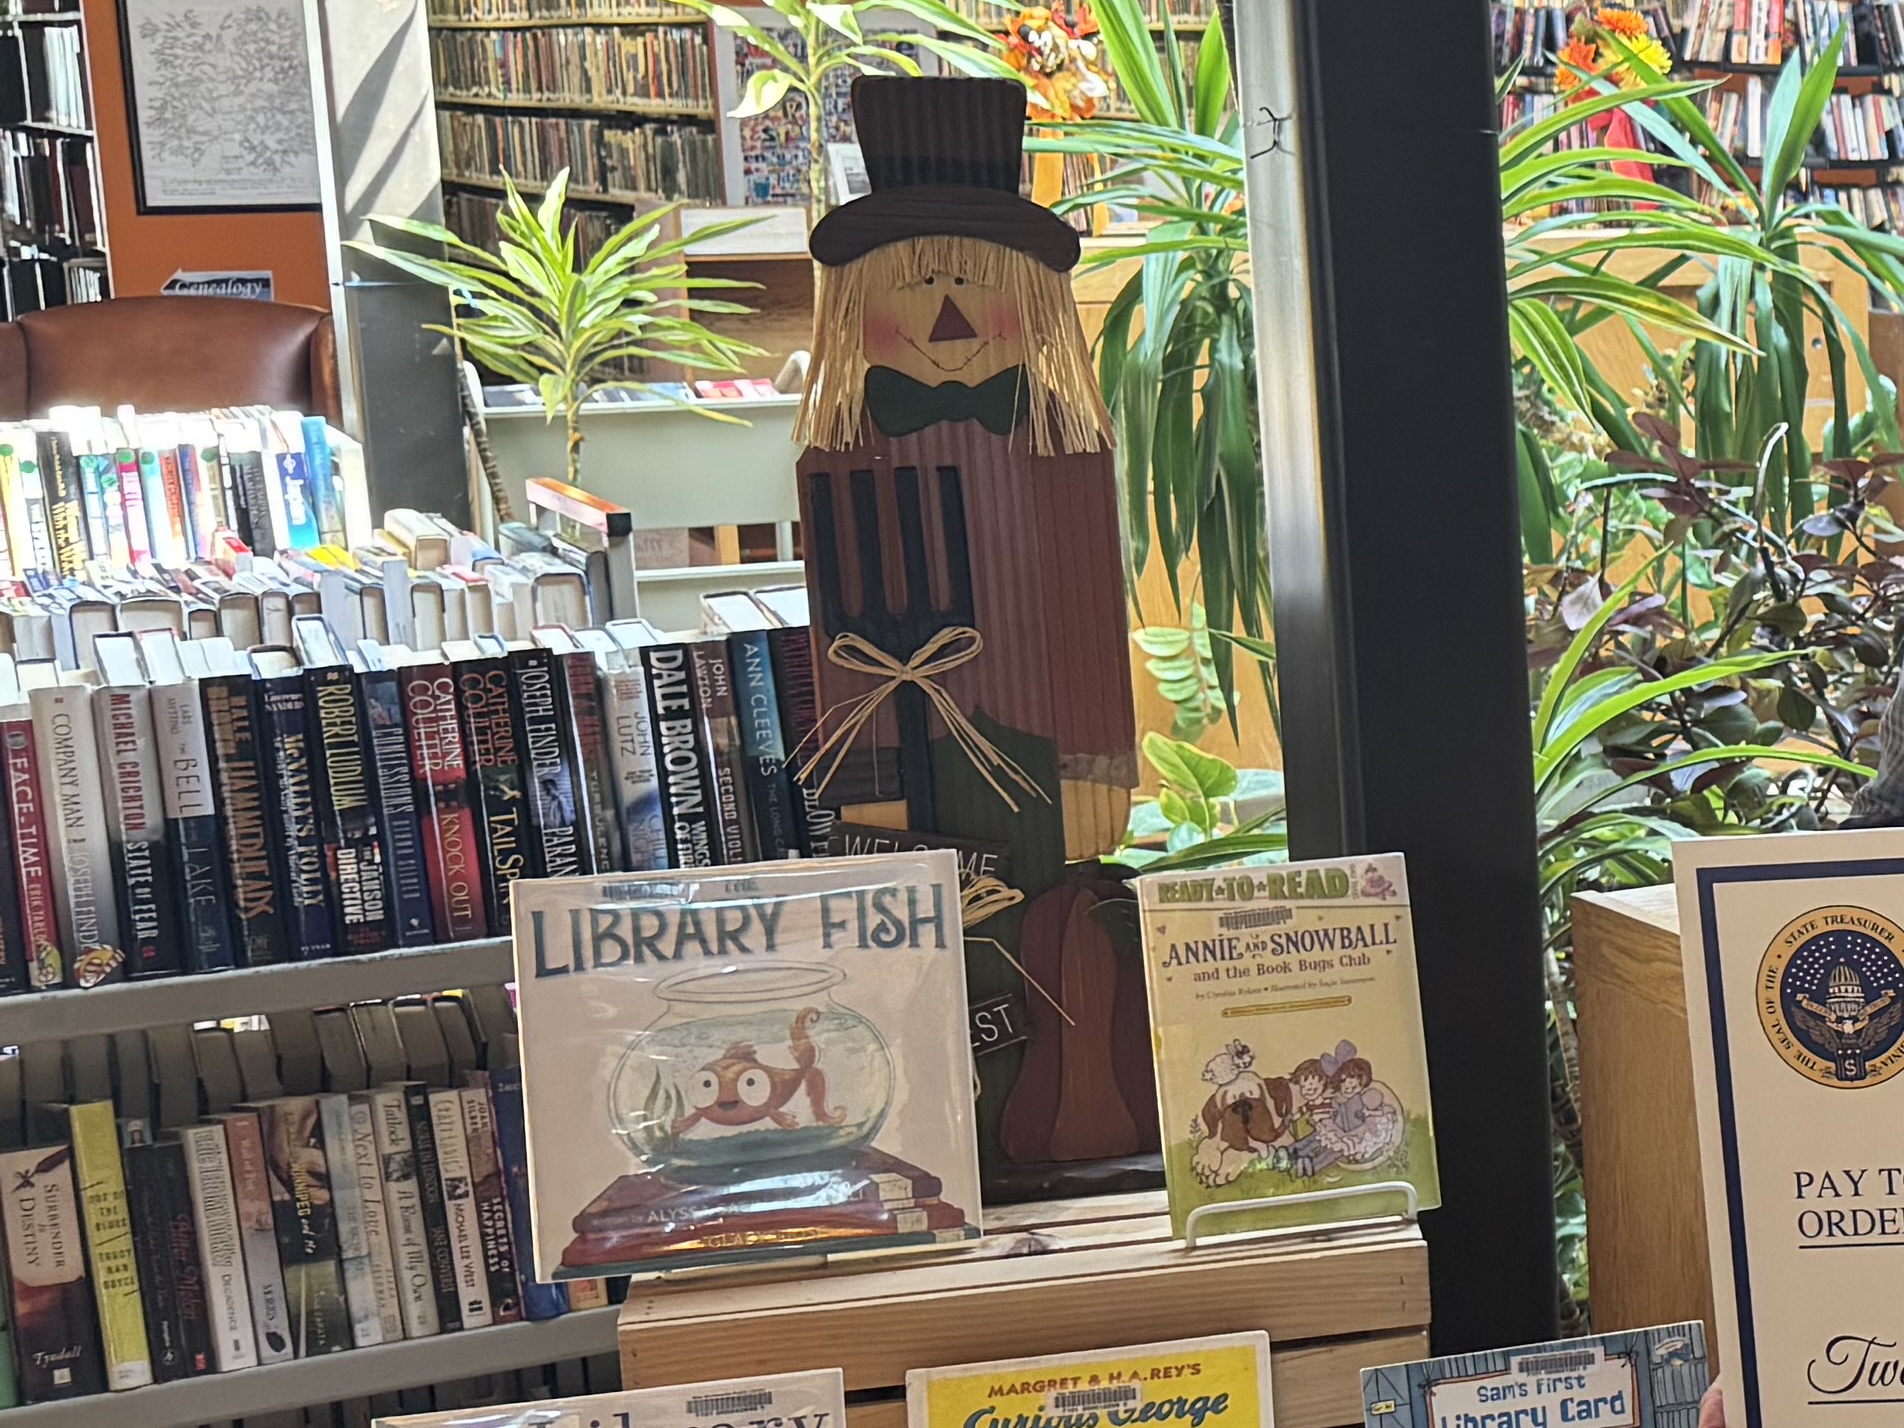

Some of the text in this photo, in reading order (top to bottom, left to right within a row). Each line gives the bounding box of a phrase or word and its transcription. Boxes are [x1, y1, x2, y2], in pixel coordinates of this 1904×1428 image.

[175, 278, 262, 299] Genealogy
[515, 665, 555, 720] JOSEPH
[709, 657, 728, 697] JOHN
[407, 679, 443, 774] COULTER
[432, 677, 464, 772] CATHERINE
[460, 673, 497, 771] COULTER
[484, 670, 518, 766] CATHERINE
[616, 715, 637, 759] LUTZ
[634, 711, 653, 758] JOHN
[650, 649, 705, 816] DALE BROWN
[744, 643, 778, 778] ANN CLEEVES
[51, 712, 85, 828] COMPANY MAN
[109, 693, 148, 832] MICHAEL CRICHTON
[316, 684, 369, 811] ROBERT LUDLUM
[173, 757, 204, 815] BELL
[717, 766, 740, 820] SECOND
[9, 757, 42, 878] FACE-TIME
[126, 840, 160, 942] STATE FEAR
[337, 847, 365, 925] DIRECTIVE
[359, 860, 385, 922] JANSON
[439, 813, 472, 921] KNOCK OUT
[1266, 867, 1350, 901] READ
[530, 882, 948, 980] LIBRARY FISH
[1162, 922, 1398, 968] ANNIE AND SNOWBALL
[1783, 919, 1819, 948] STATE
[1822, 913, 1896, 945] TREASURER
[1193, 952, 1371, 983] and the Book Bugs Club
[1765, 965, 1779, 991] THE
[1765, 997, 1777, 1015] OF
[1770, 1017, 1794, 1051] SEAL
[354, 1129, 381, 1237] Next Love
[1793, 1168, 1871, 1202] PAY
[19, 1197, 41, 1267] DESTINY
[44, 1183, 65, 1269] SURRENDER
[99, 1206, 118, 1218] THE
[479, 1201, 498, 1273] HAPPINESS
[492, 1196, 512, 1253] SECRETS
[102, 1276, 136, 1291] BOYCE
[410, 1274, 428, 1304] Own
[459, 1244, 475, 1289] LEE WEST
[987, 1362, 1203, 1399] MARGRET & H.A.REY'S
[1476, 1375, 1587, 1405] Sam's First
[1559, 1390, 1627, 1424] Card
[1107, 1391, 1231, 1428] George
